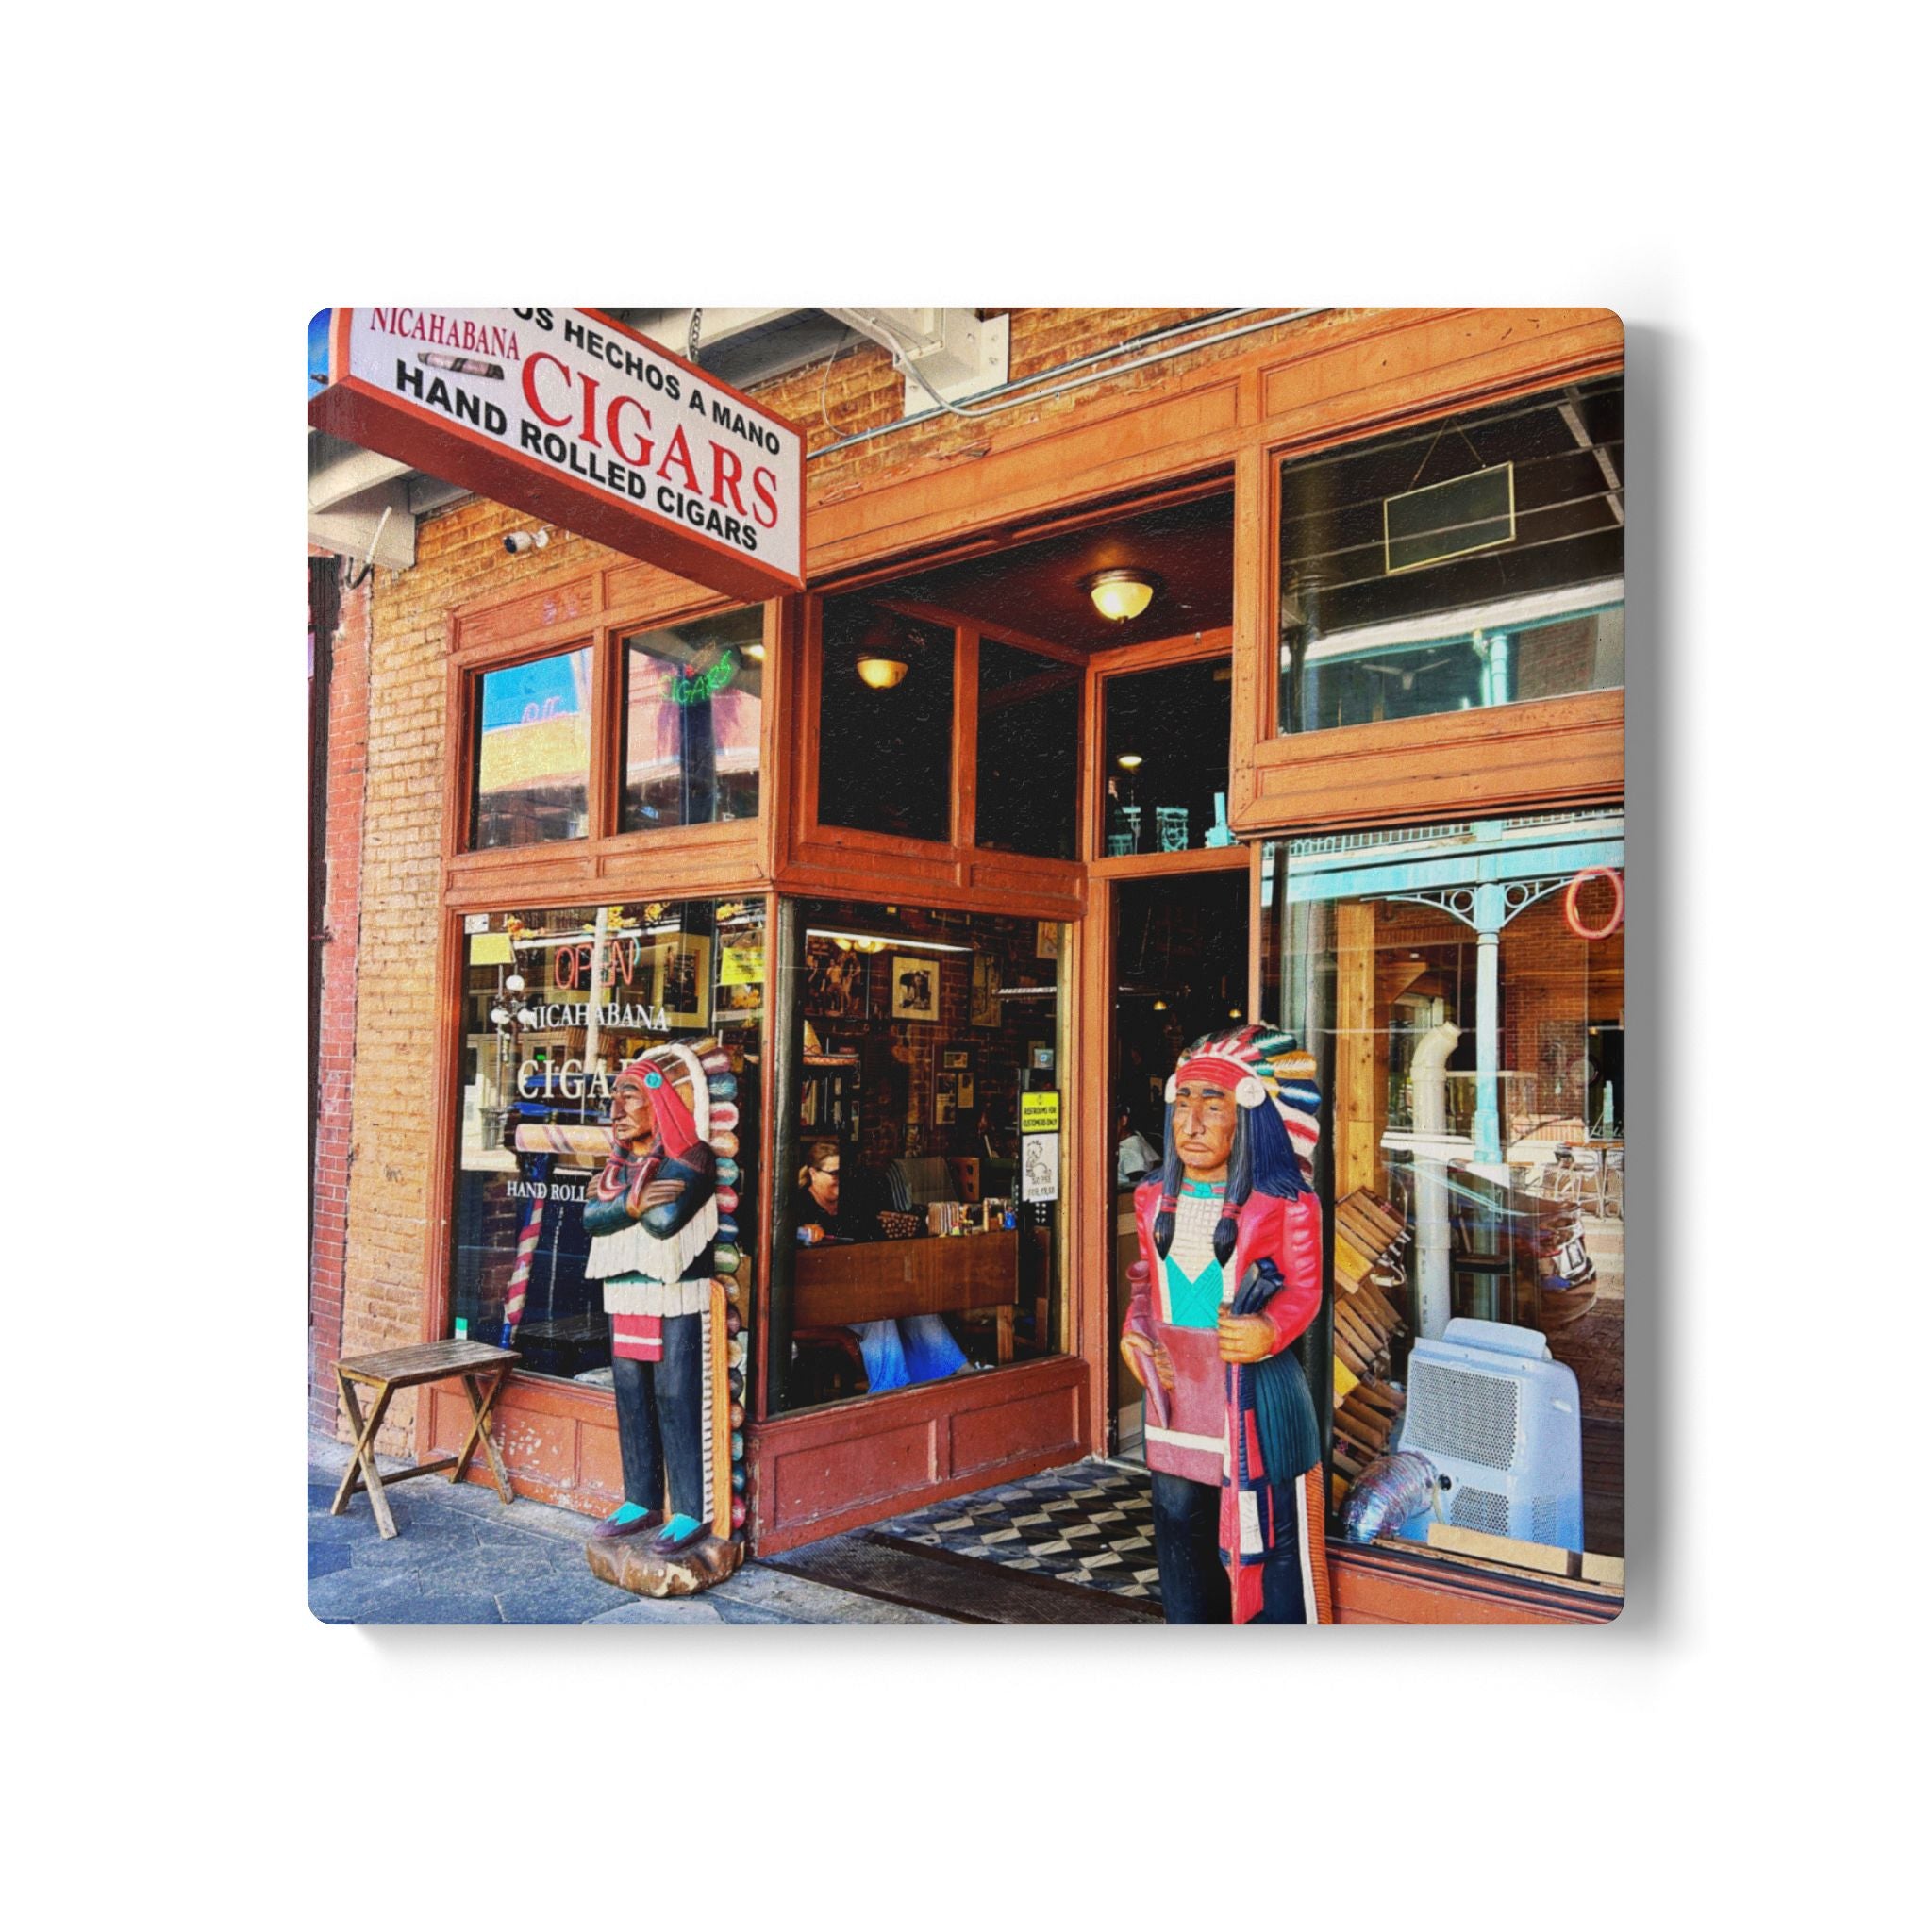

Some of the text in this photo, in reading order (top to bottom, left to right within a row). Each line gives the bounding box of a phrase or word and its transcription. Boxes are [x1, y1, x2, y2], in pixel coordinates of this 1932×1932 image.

[370, 308, 520, 360] NICAHABANA
[564, 319, 681, 401] HECHOS
[689, 389, 706, 416] A
[712, 401, 780, 456] MANO
[396, 358, 758, 551] HAND ROLLED CIGARS
[522, 352, 778, 528] CIGARS
[555, 940, 635, 989] OPEN
[522, 1002, 671, 1032] NICAHABANA
[506, 1180, 547, 1199] HAND
